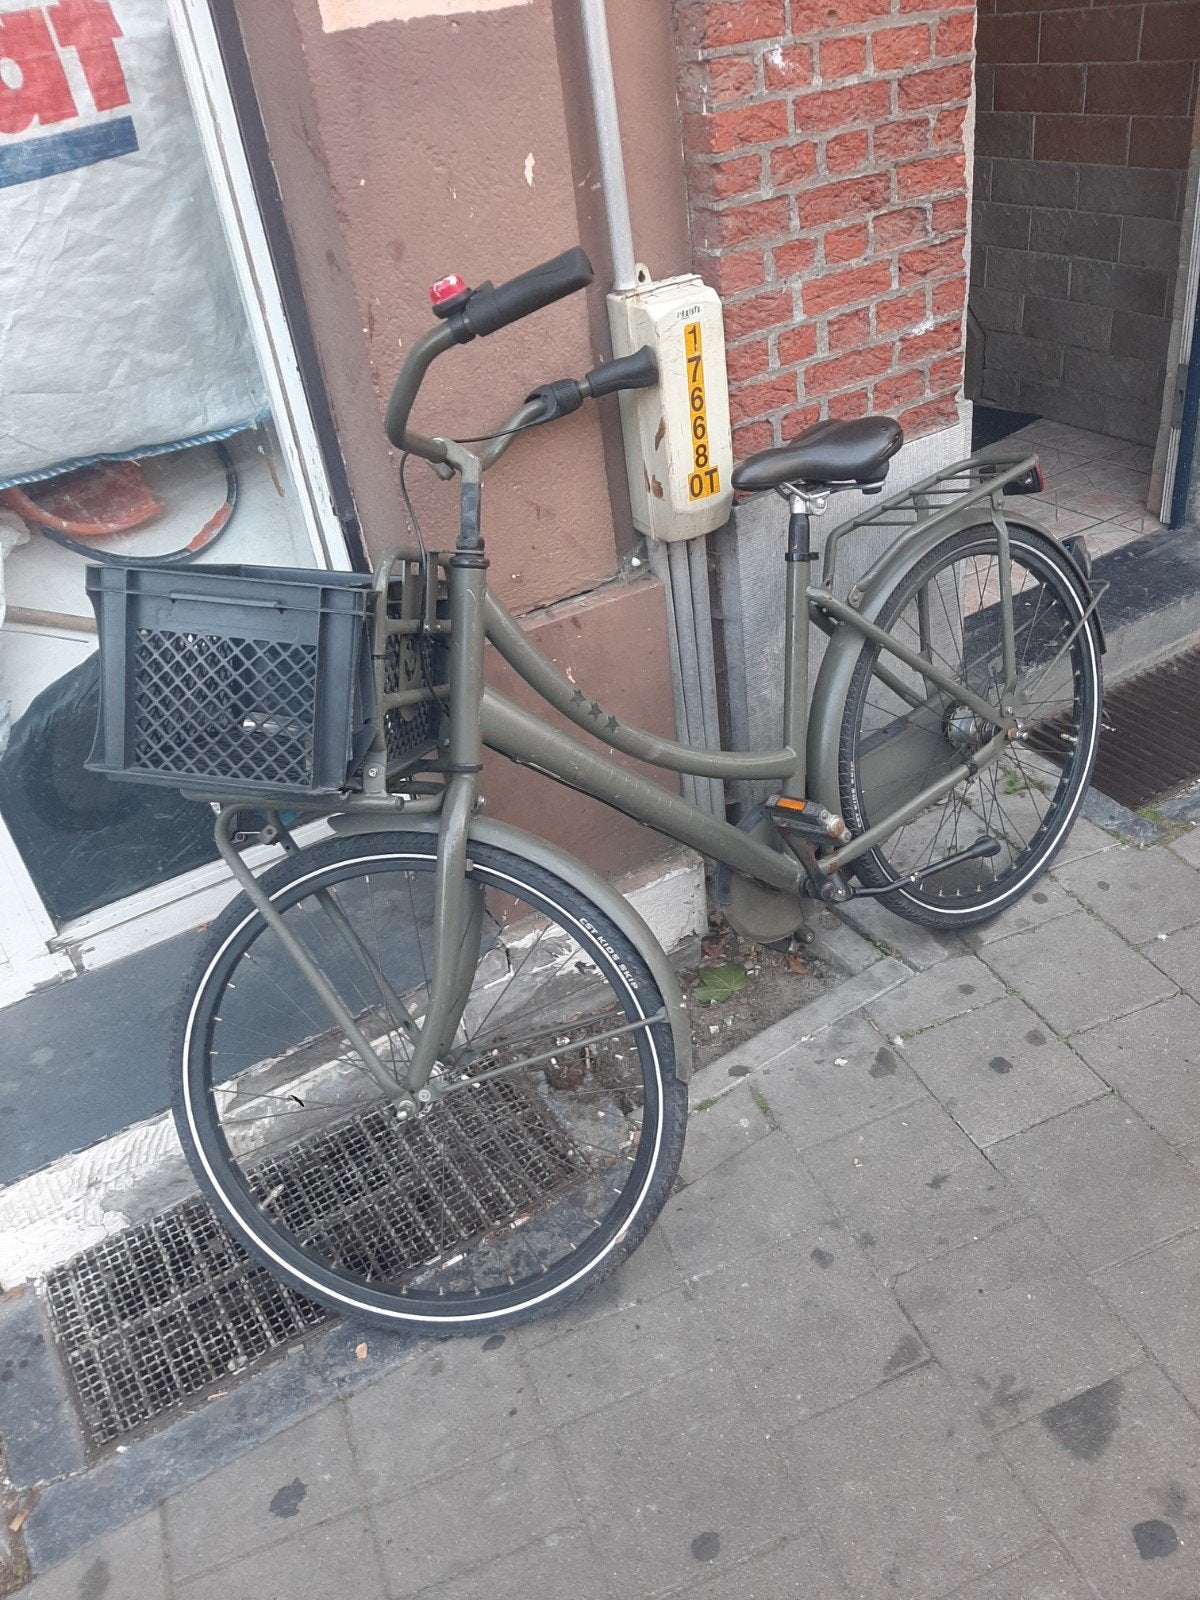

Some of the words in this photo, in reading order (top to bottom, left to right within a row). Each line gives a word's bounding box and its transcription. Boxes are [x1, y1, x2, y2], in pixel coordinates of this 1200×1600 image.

[687, 325, 708, 468] 17668
[579, 917, 599, 935] CST
[596, 935, 621, 961] KIDS
[618, 963, 639, 989] SKIP
